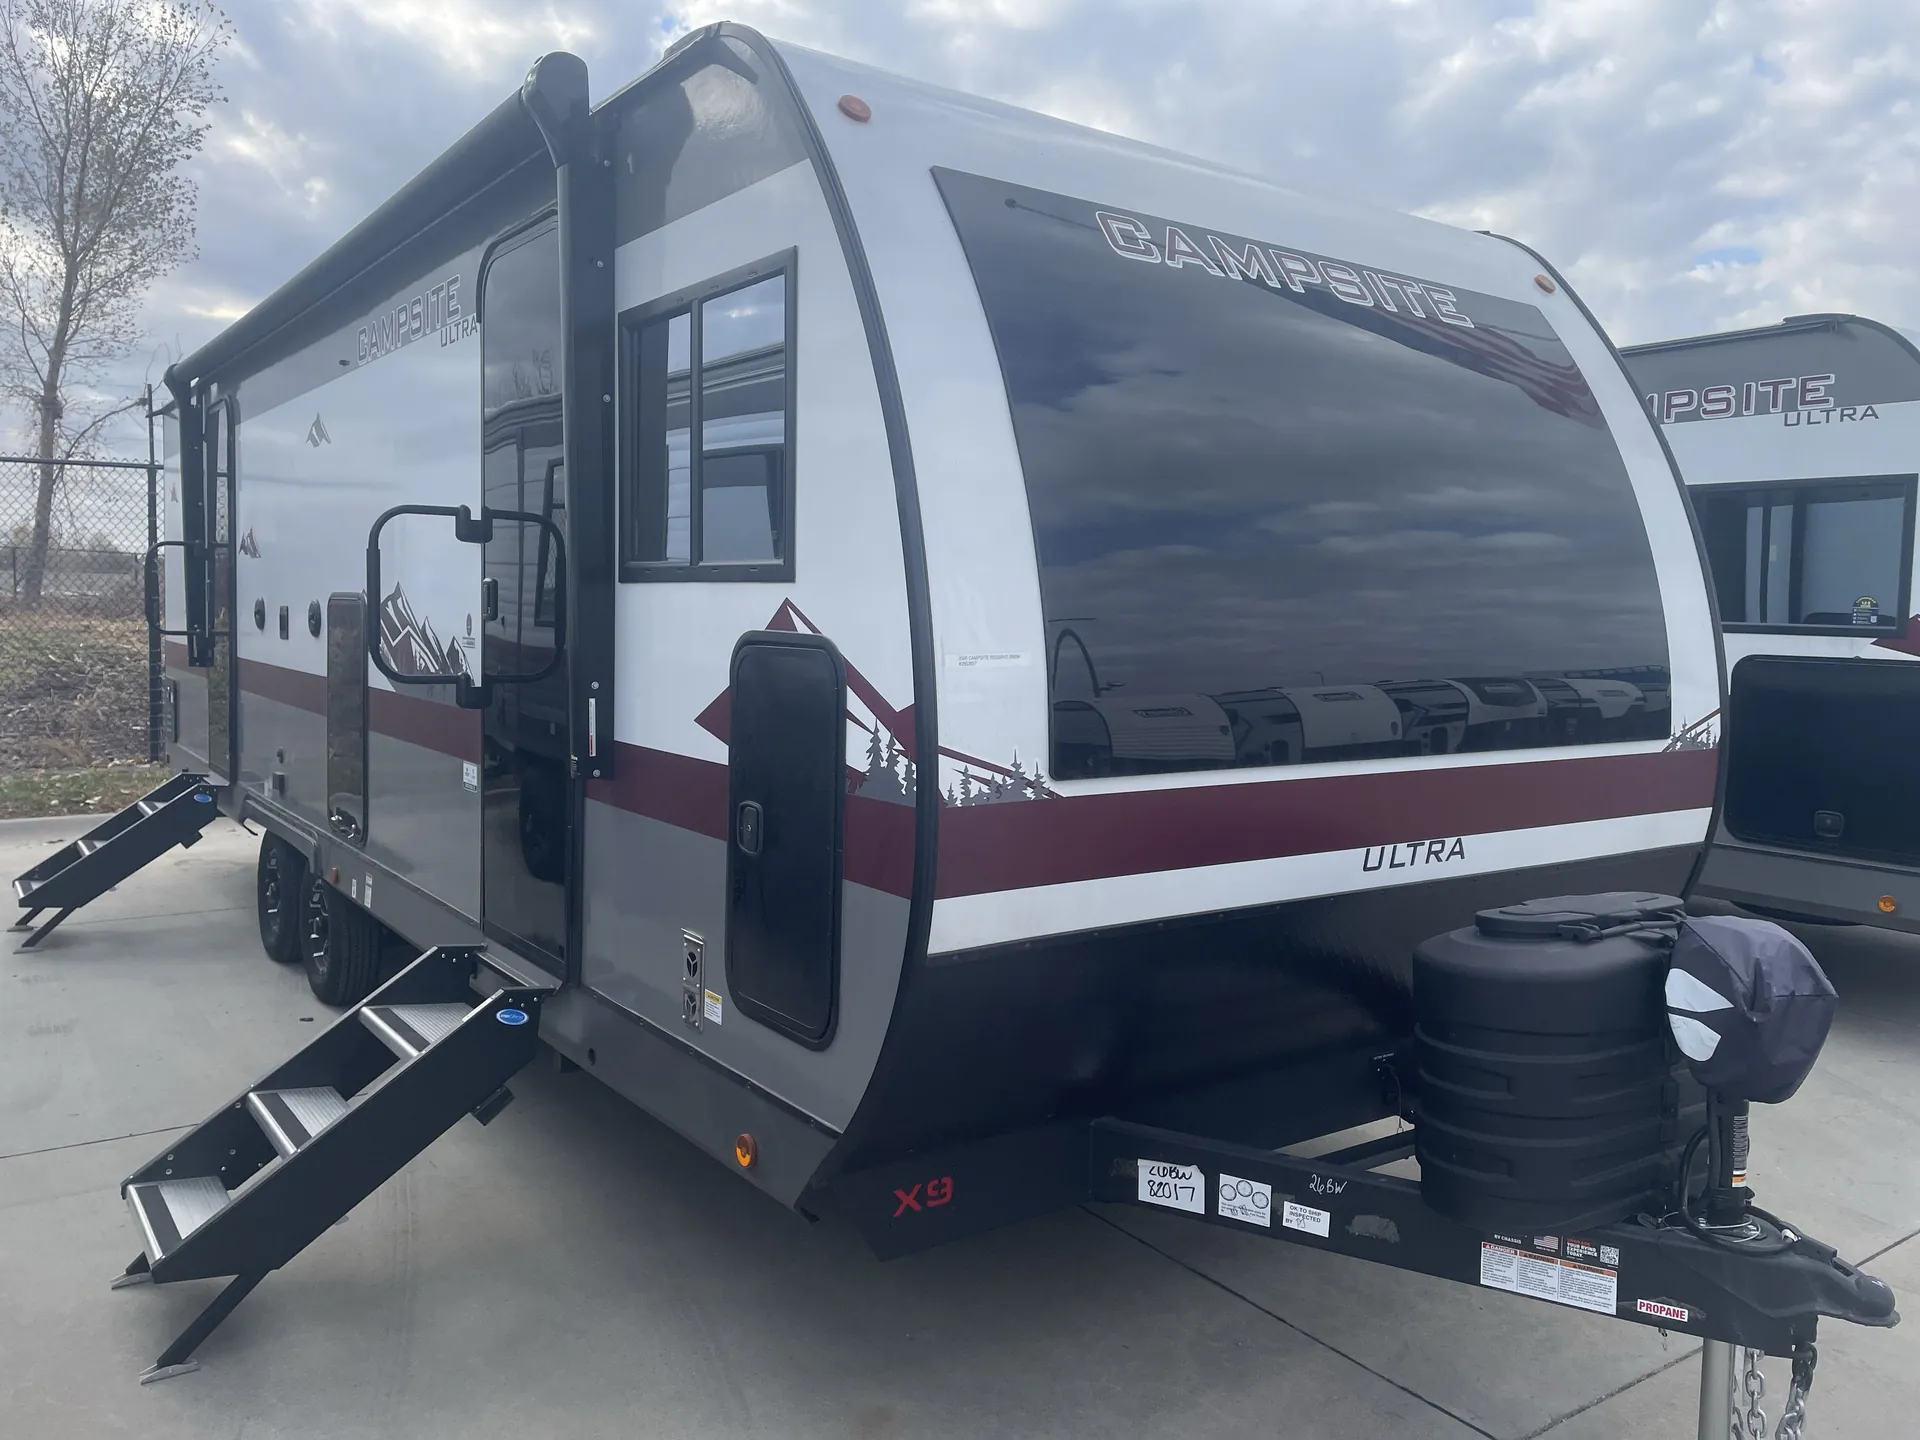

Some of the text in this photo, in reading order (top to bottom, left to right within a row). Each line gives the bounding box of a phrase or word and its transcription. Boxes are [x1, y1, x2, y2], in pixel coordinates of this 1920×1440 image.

[1095, 210, 1475, 329] CAMPSITE
[356, 273, 461, 367] CAMPSITE
[440, 314, 478, 348] ULTRA
[1783, 405, 1880, 428] ULTRA
[1362, 837, 1466, 872] ULTRA
[1147, 1179, 1196, 1203] 82017
[1309, 1173, 1348, 1195] 26BW
[1289, 1211, 1321, 1223] INSPECTED
[1490, 1245, 1515, 1255] DANGER
[1501, 1235, 1522, 1245] CHASSIS
[1638, 1301, 1687, 1321] PROPANE
